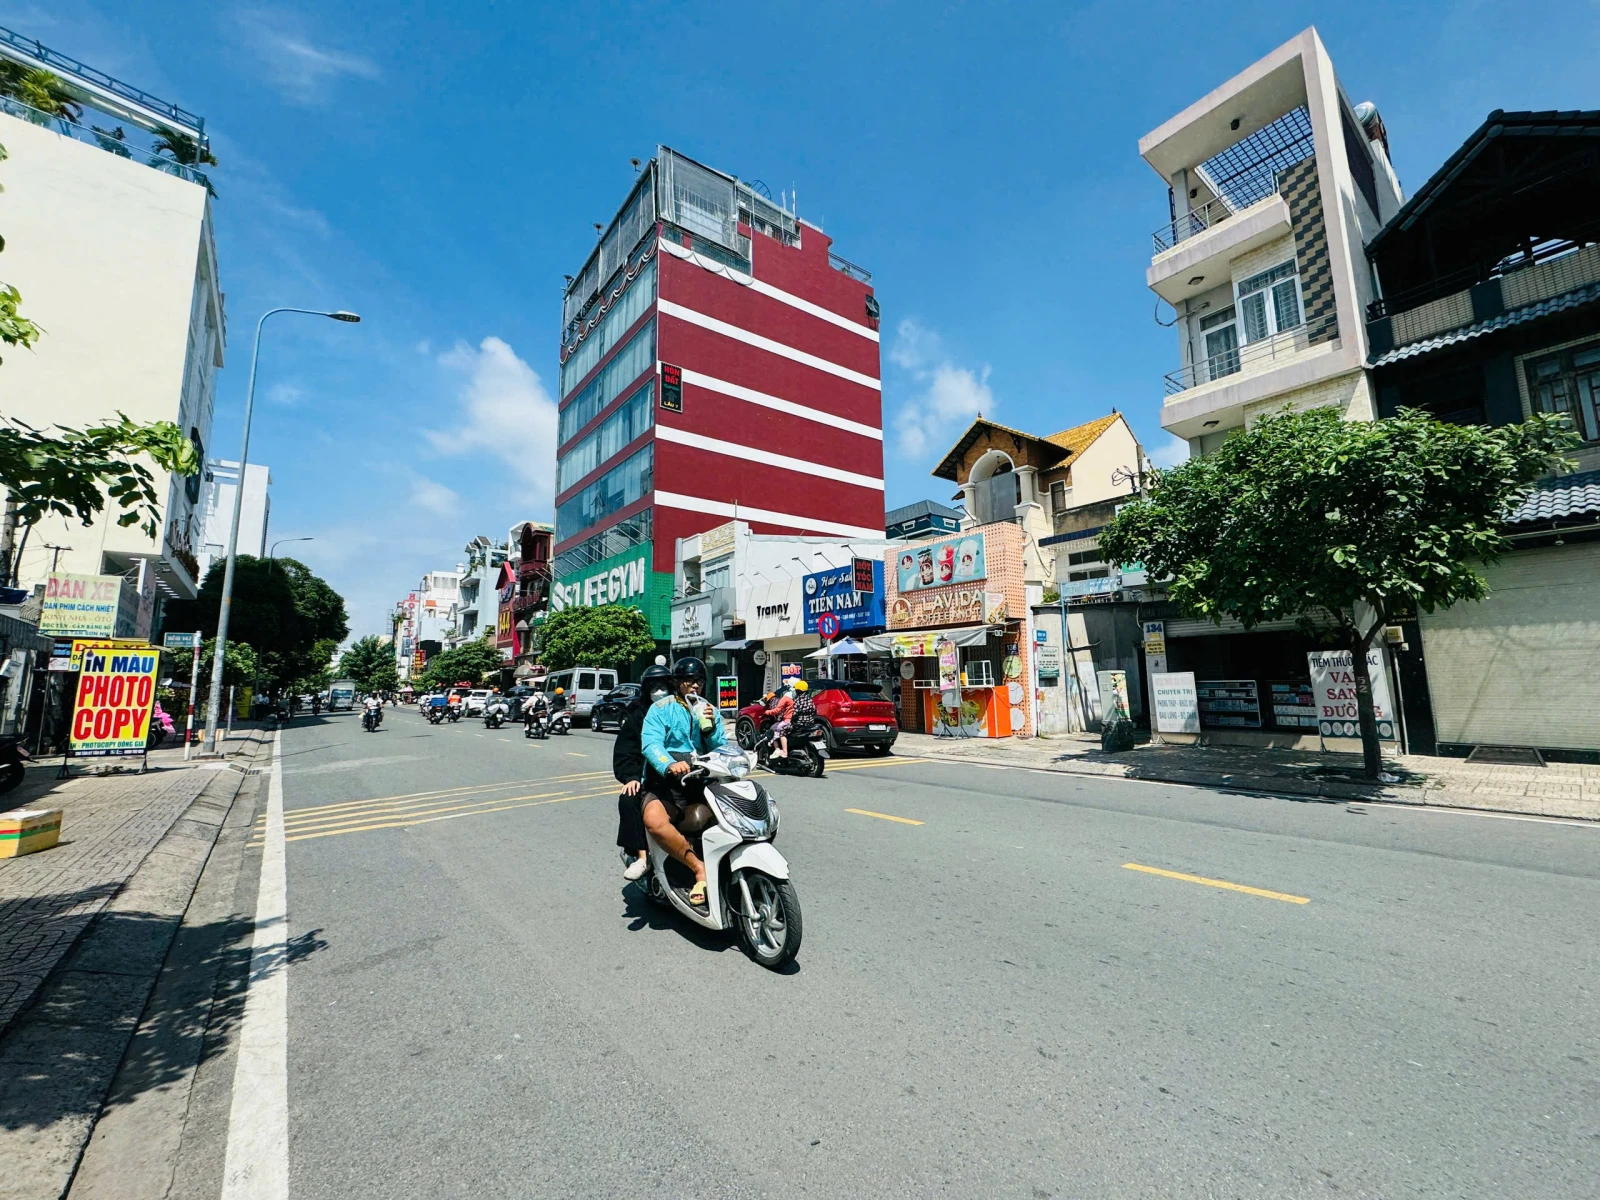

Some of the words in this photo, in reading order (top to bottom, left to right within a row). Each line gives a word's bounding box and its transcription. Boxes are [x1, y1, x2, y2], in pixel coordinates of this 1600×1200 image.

[90, 580, 116, 601] XE
[921, 588, 983, 612] LAVIDA
[60, 602, 76, 611] PHIM
[756, 602, 789, 618] Tranny
[808, 590, 834, 614] TIẾN
[836, 591, 863, 610] NAM
[1145, 623, 1163, 633] 134
[110, 653, 155, 674] MÀU
[1311, 655, 1330, 670] TIỆM
[1332, 652, 1354, 668] THUỐ
[78, 675, 153, 708] PHOTO
[1323, 702, 1383, 718] ĐƯỜG
[74, 708, 148, 740] COPY
